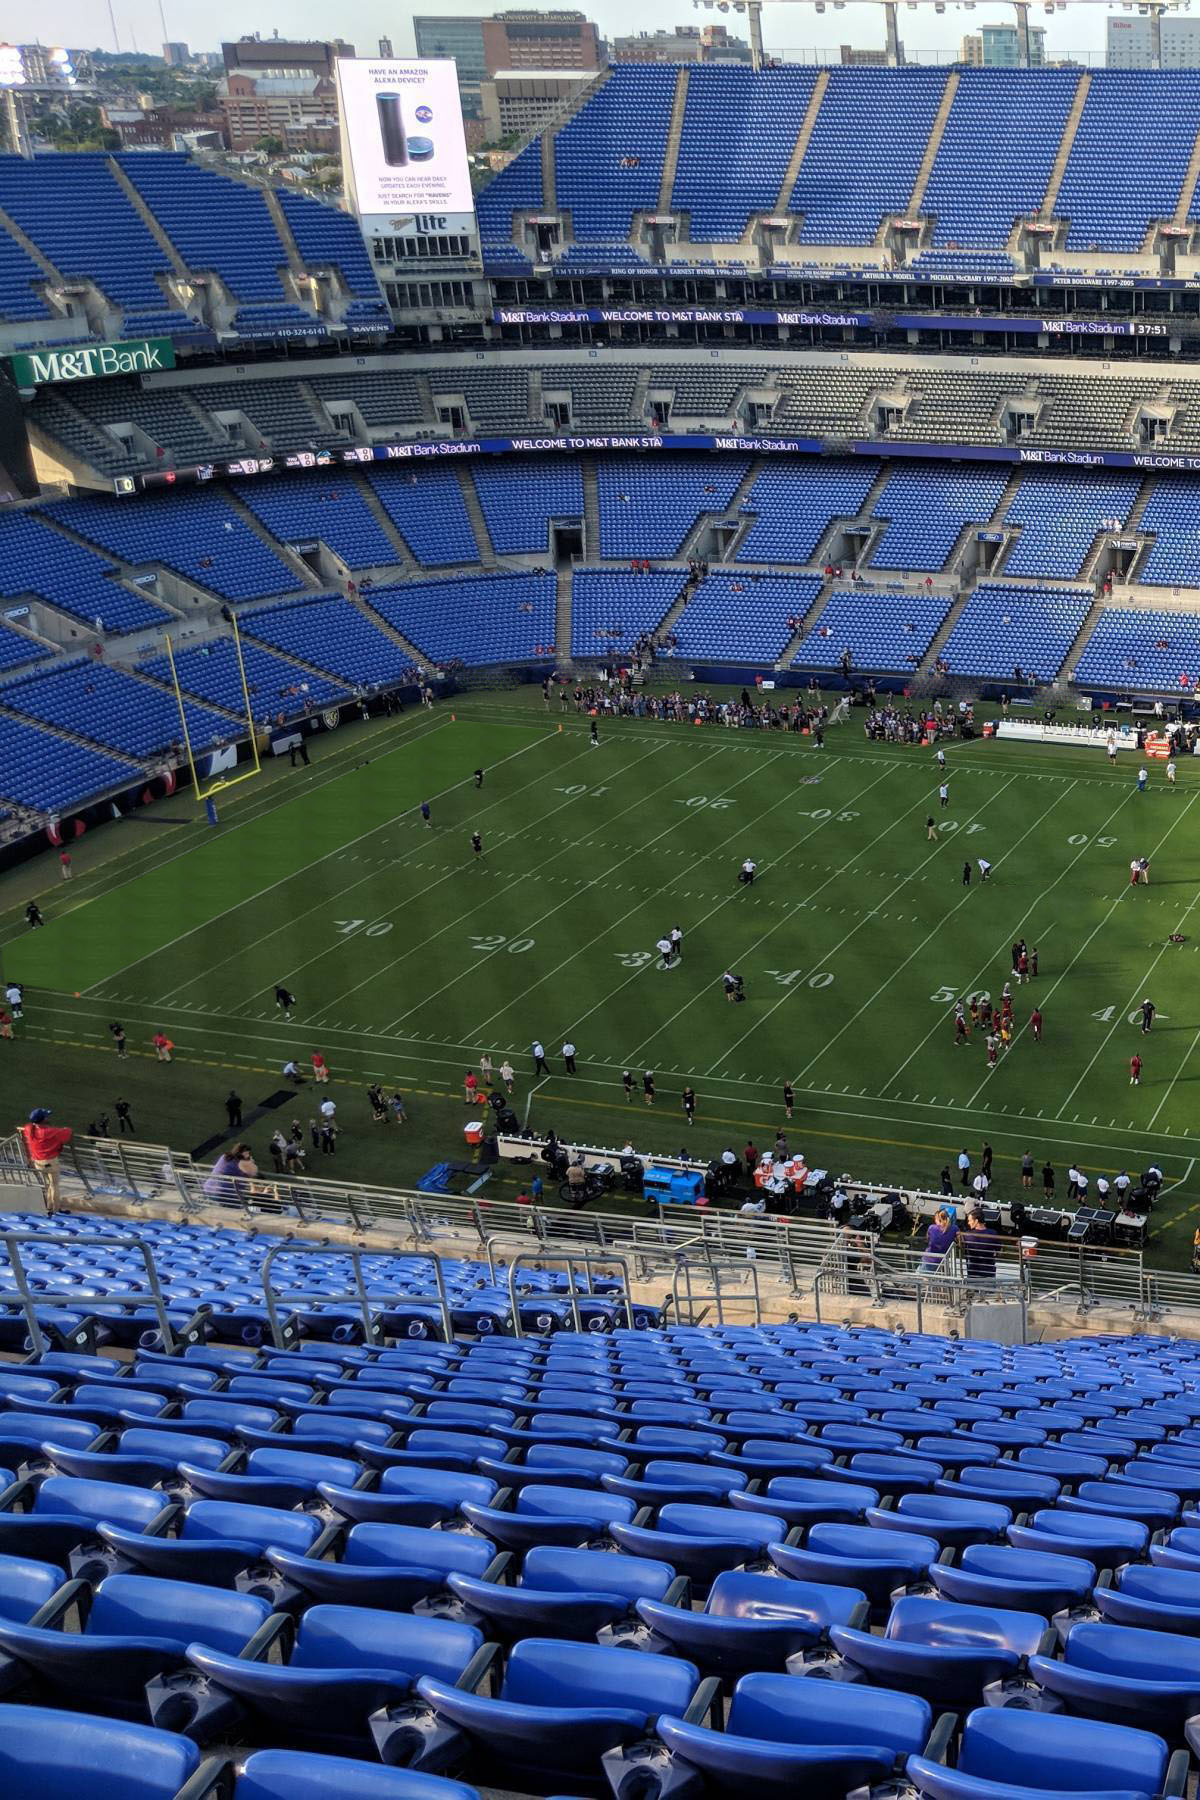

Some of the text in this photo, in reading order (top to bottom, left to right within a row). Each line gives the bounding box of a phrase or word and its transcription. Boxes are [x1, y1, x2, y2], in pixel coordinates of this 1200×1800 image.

[413, 214, 447, 235] Lite
[637, 268, 659, 276] HONOR
[862, 273, 885, 281] ARTHUR
[893, 273, 916, 281] MODELL
[930, 273, 955, 282] MICHAEL
[1053, 277, 1070, 285] PETER
[1071, 278, 1102, 286] BOULWARE
[501, 311, 589, 323] M&T Bank Stadium
[602, 311, 653, 321] WELCOME
[655, 311, 670, 321] TO
[672, 311, 693, 321] M&T
[695, 311, 723, 322] BANK
[1042, 321, 1125, 334] M&T Bank Stadium
[1138, 324, 1167, 335] 37:51
[29, 342, 163, 382] M&T Bank
[512, 438, 567, 450] WELCOME
[569, 438, 584, 448] TO
[586, 437, 609, 448] M&T
[612, 437, 639, 447] BANK
[387, 442, 480, 458] M&T Bank Stadium
[1020, 450, 1104, 464] M&T Bank Stadium
[1133, 456, 1185, 468] WELCOME
